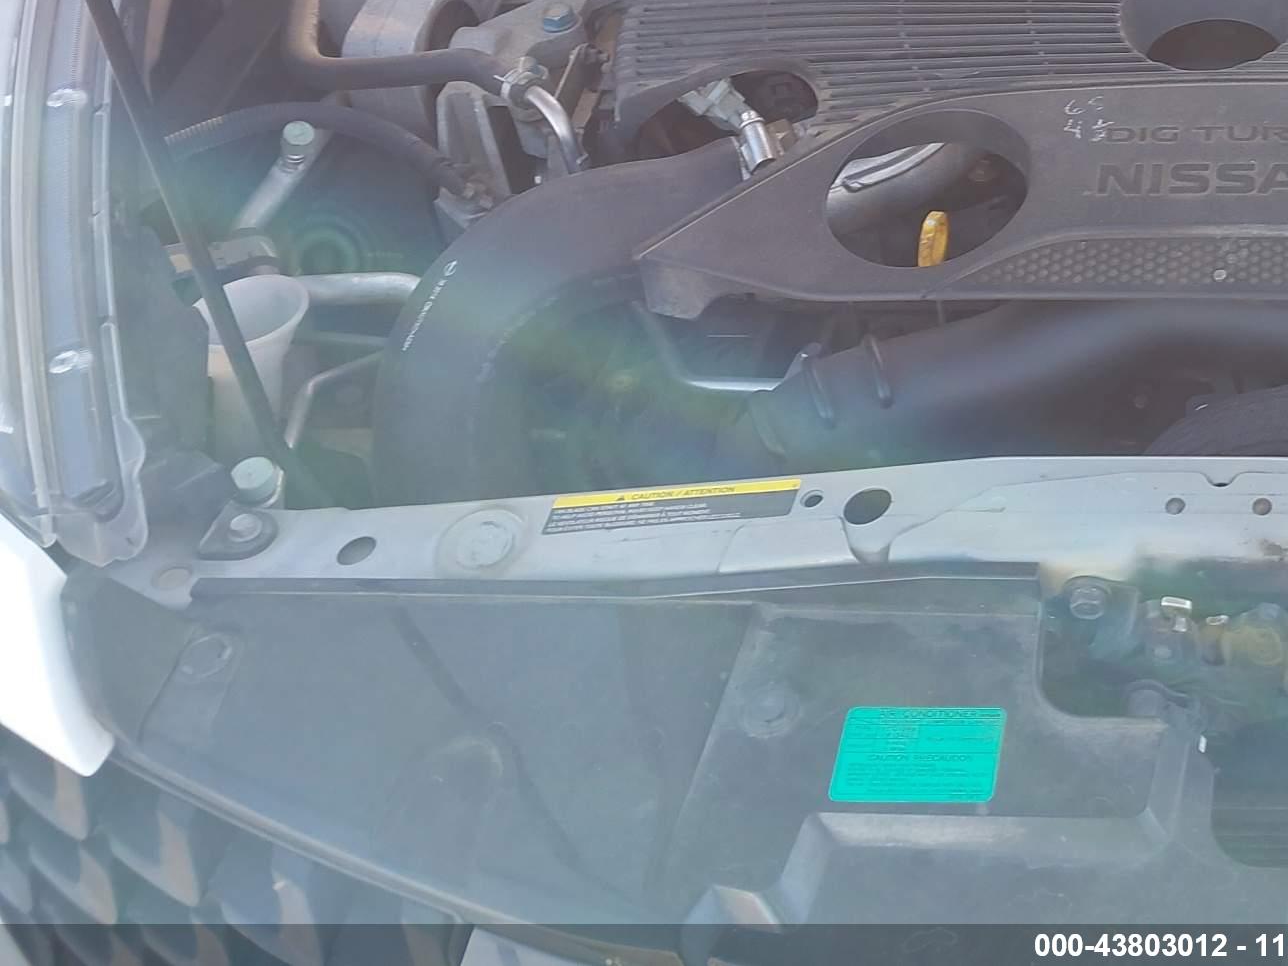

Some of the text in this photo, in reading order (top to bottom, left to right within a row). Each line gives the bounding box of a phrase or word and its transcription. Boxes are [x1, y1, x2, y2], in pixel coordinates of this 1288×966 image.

[1103, 124, 1180, 143] DIG
[631, 490, 674, 500] CAUTION
[682, 486, 736, 496] ATTENTION
